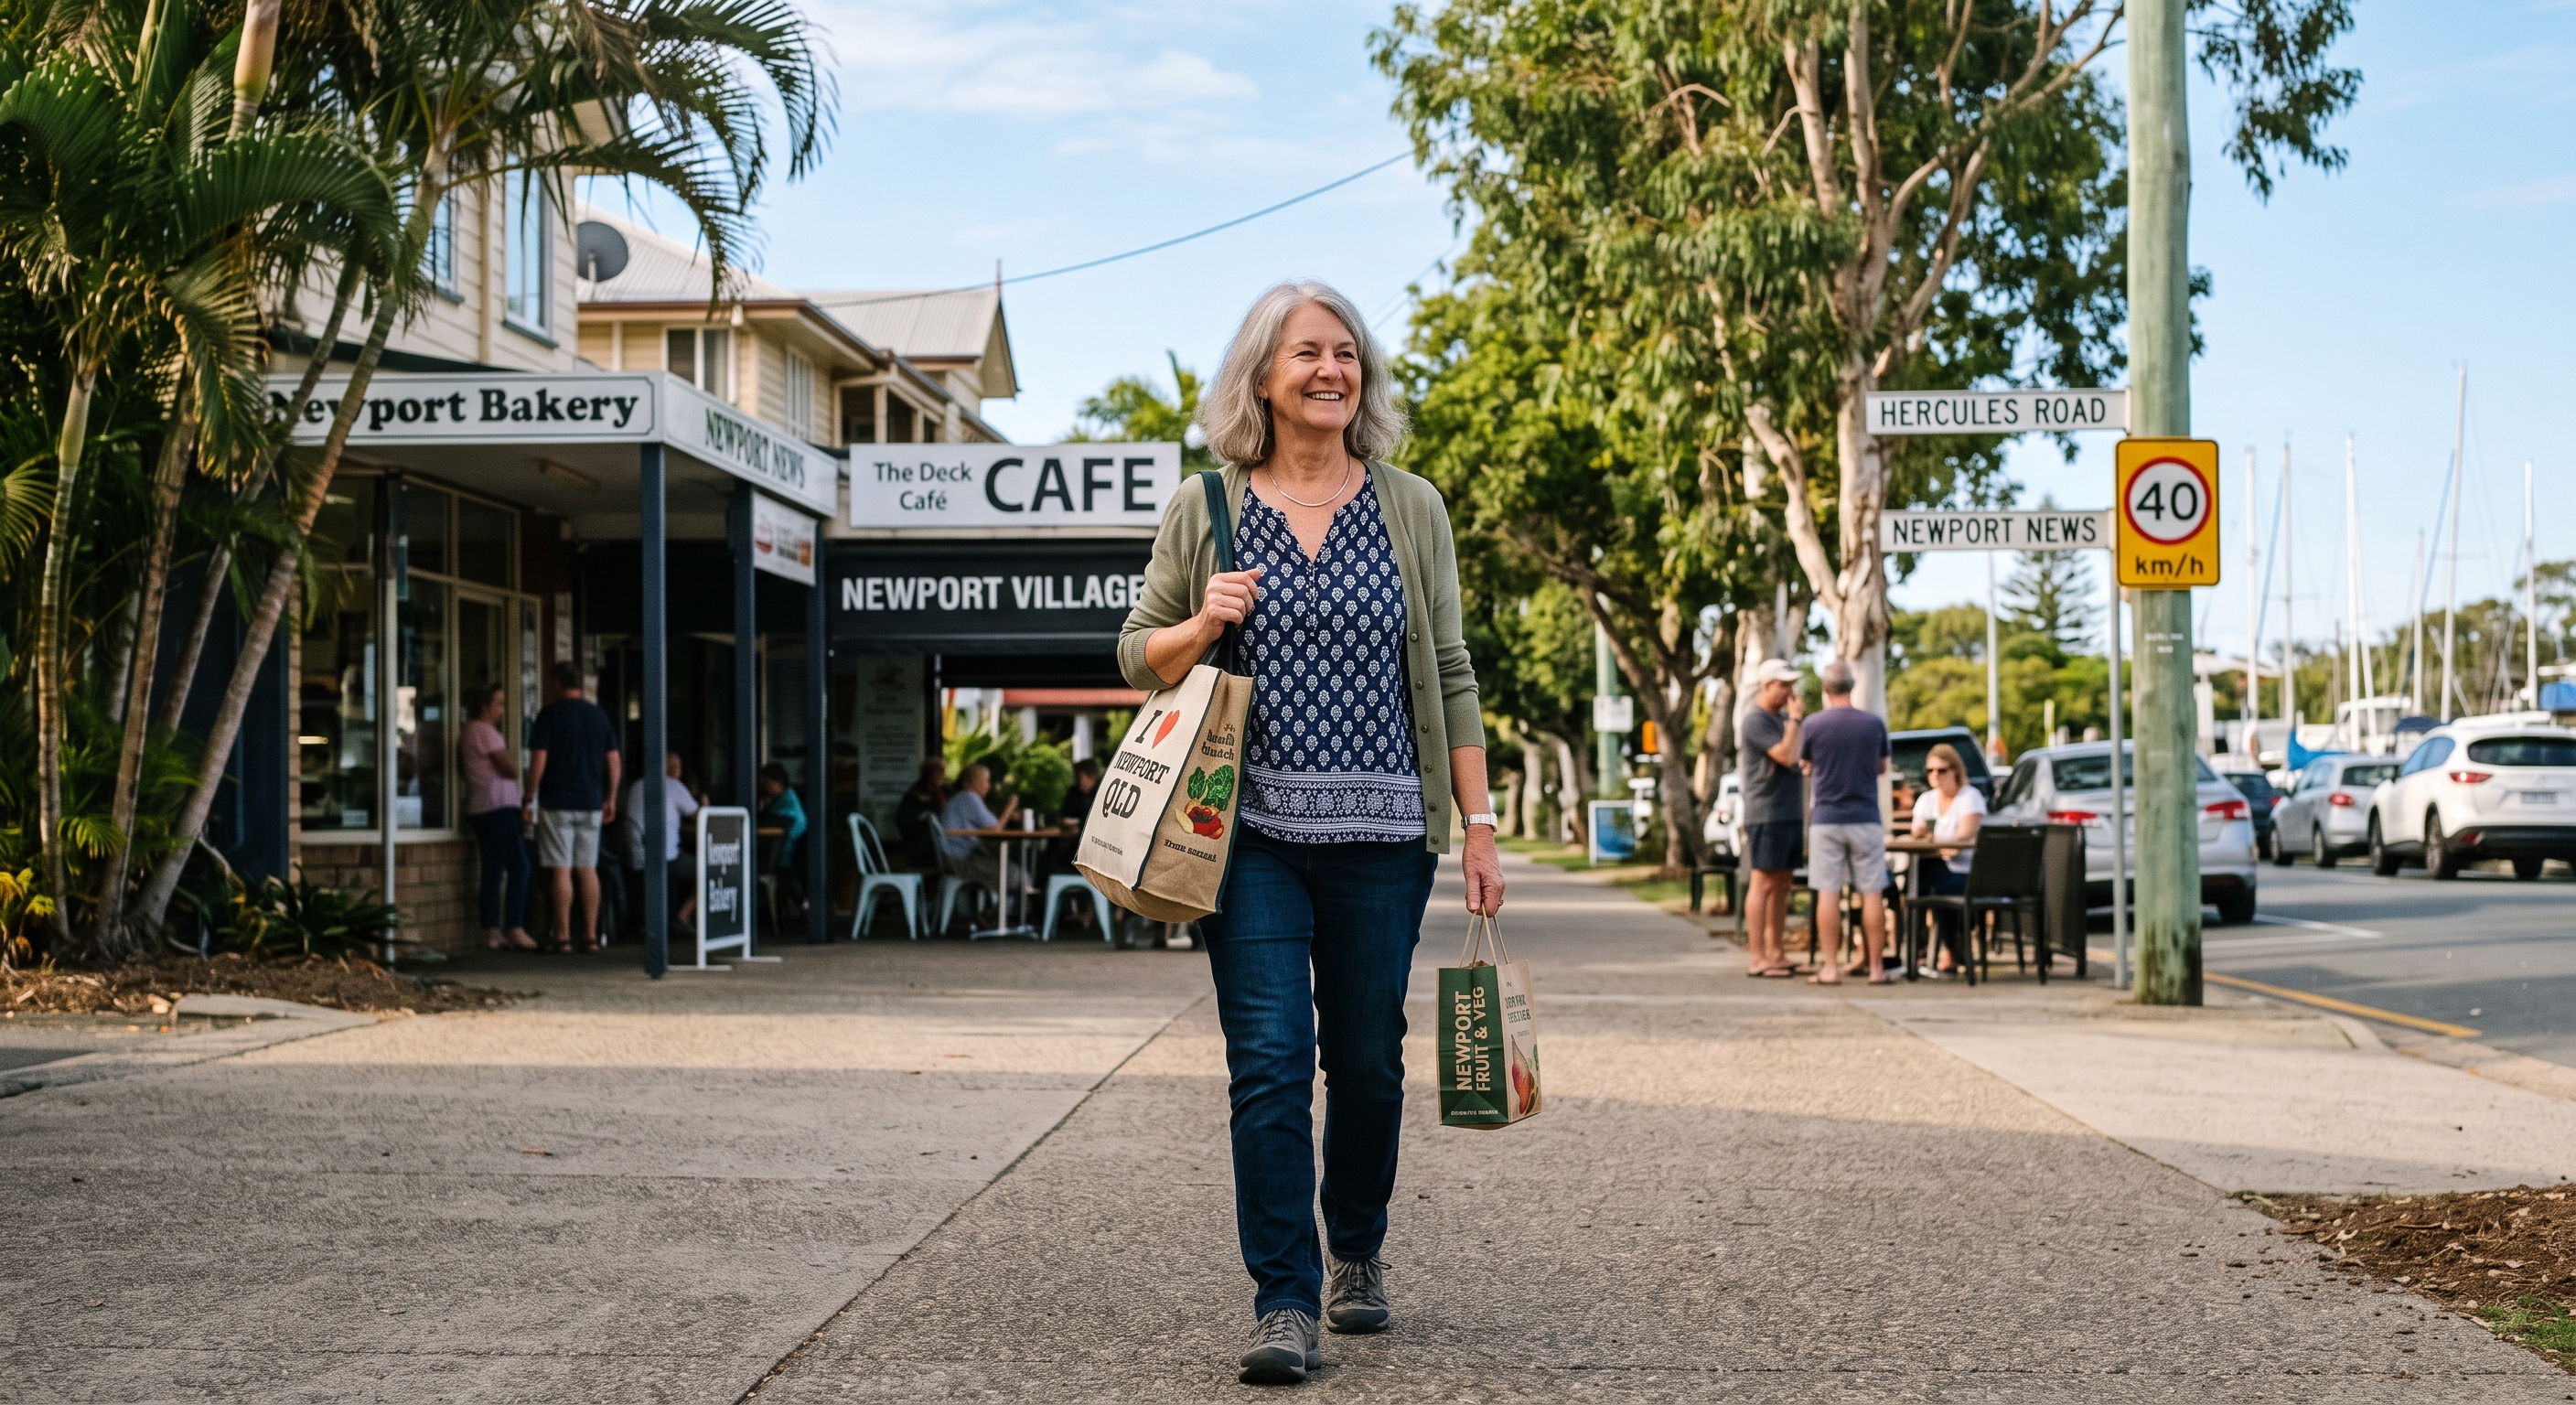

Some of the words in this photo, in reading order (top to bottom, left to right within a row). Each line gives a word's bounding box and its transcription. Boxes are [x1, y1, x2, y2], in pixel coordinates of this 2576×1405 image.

[478, 388, 639, 429] Bakery
[1881, 399, 2019, 427] HERCULES
[2035, 397, 2106, 424] ROAD
[704, 407, 768, 473] NEWPORT
[771, 442, 805, 490] NEWS
[874, 462, 913, 482] The
[919, 462, 971, 482] Deck
[984, 456, 1156, 513] CAFE
[899, 489, 948, 511] Café
[2136, 481, 2198, 520] 40
[1893, 518, 2014, 544] NEWPORT
[2027, 515, 2097, 542] NEWS
[2135, 552, 2205, 578] km/h
[842, 576, 1003, 611] NEWPORT
[1011, 574, 1146, 610] VILLAGE
[1134, 709, 1163, 744] I
[1102, 778, 1142, 819] QLD
[1473, 986, 1487, 1022] VEG
[1454, 991, 1473, 1091] NEWPORT
[1474, 1025, 1487, 1039] &
[1475, 1044, 1491, 1092] FRUIT
